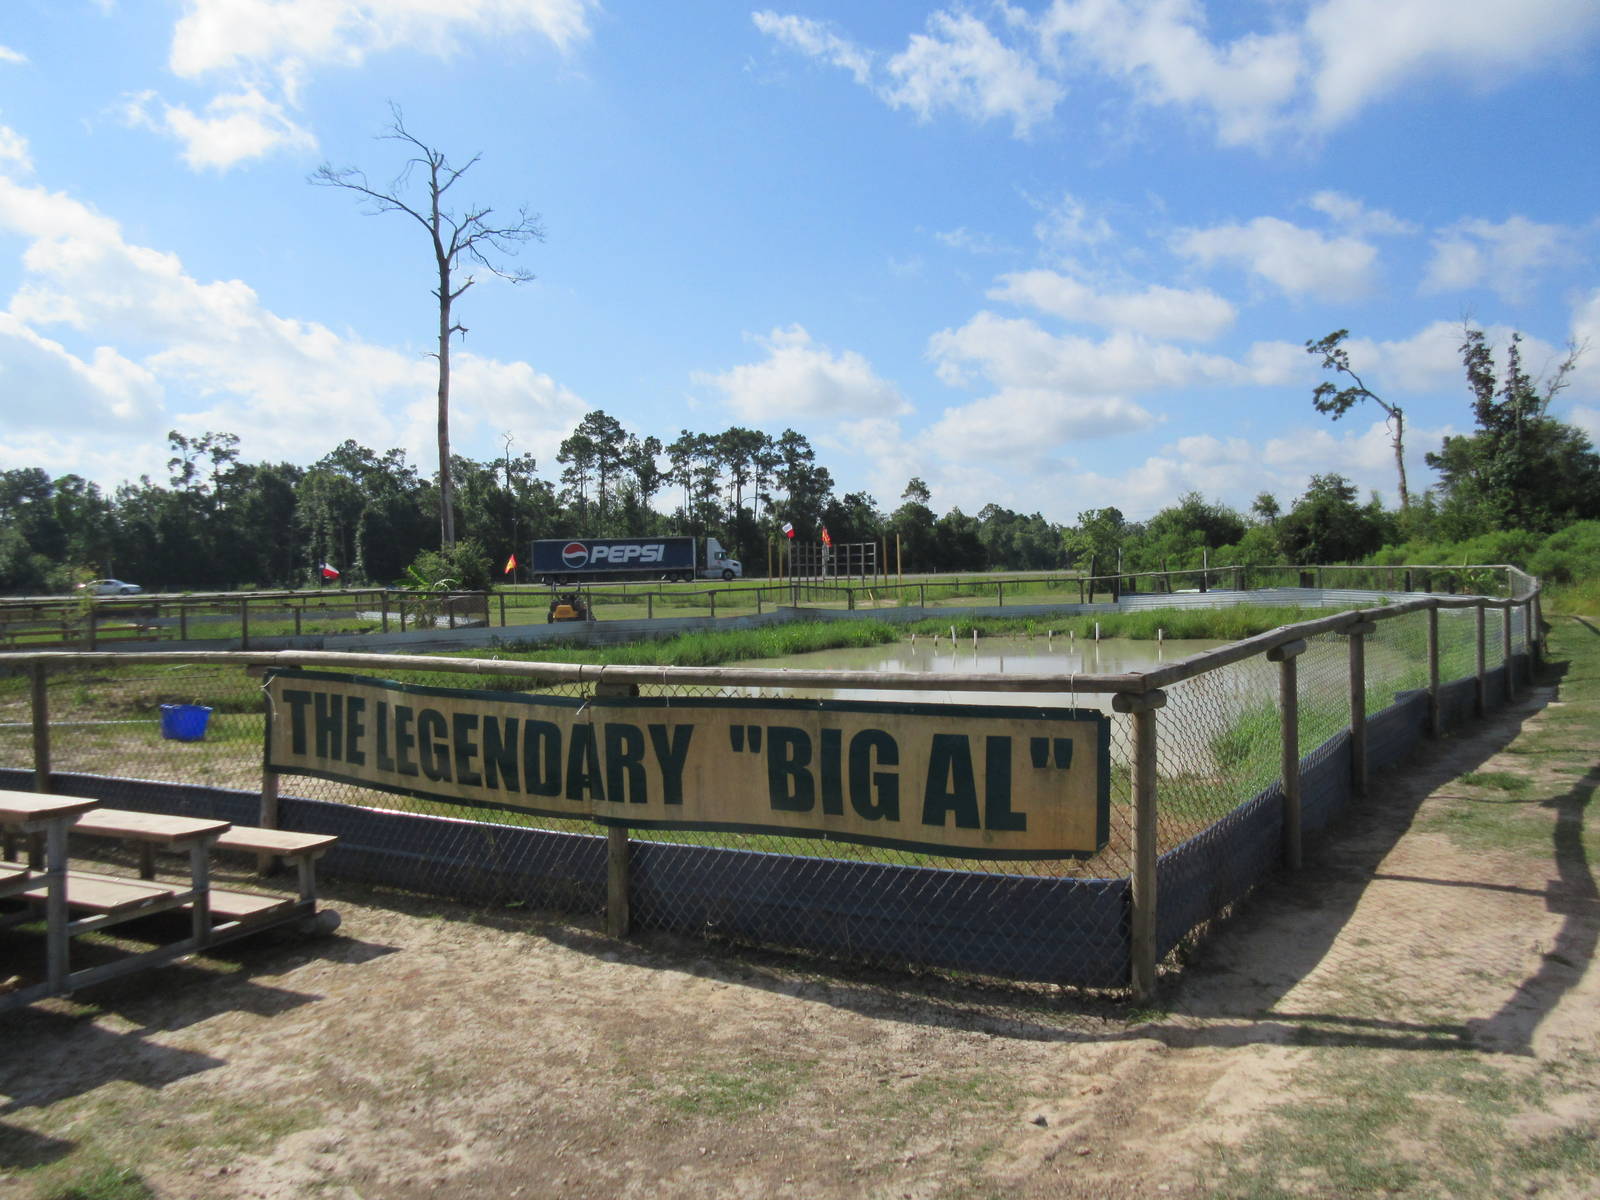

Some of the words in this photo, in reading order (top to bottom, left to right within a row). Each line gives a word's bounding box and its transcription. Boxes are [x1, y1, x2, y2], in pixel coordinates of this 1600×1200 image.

[591, 545, 664, 563] PEPSI
[282, 689, 366, 767] THE
[376, 701, 694, 805] LEGENDARY
[729, 724, 900, 822] "BIG
[922, 733, 1073, 832] AL"
